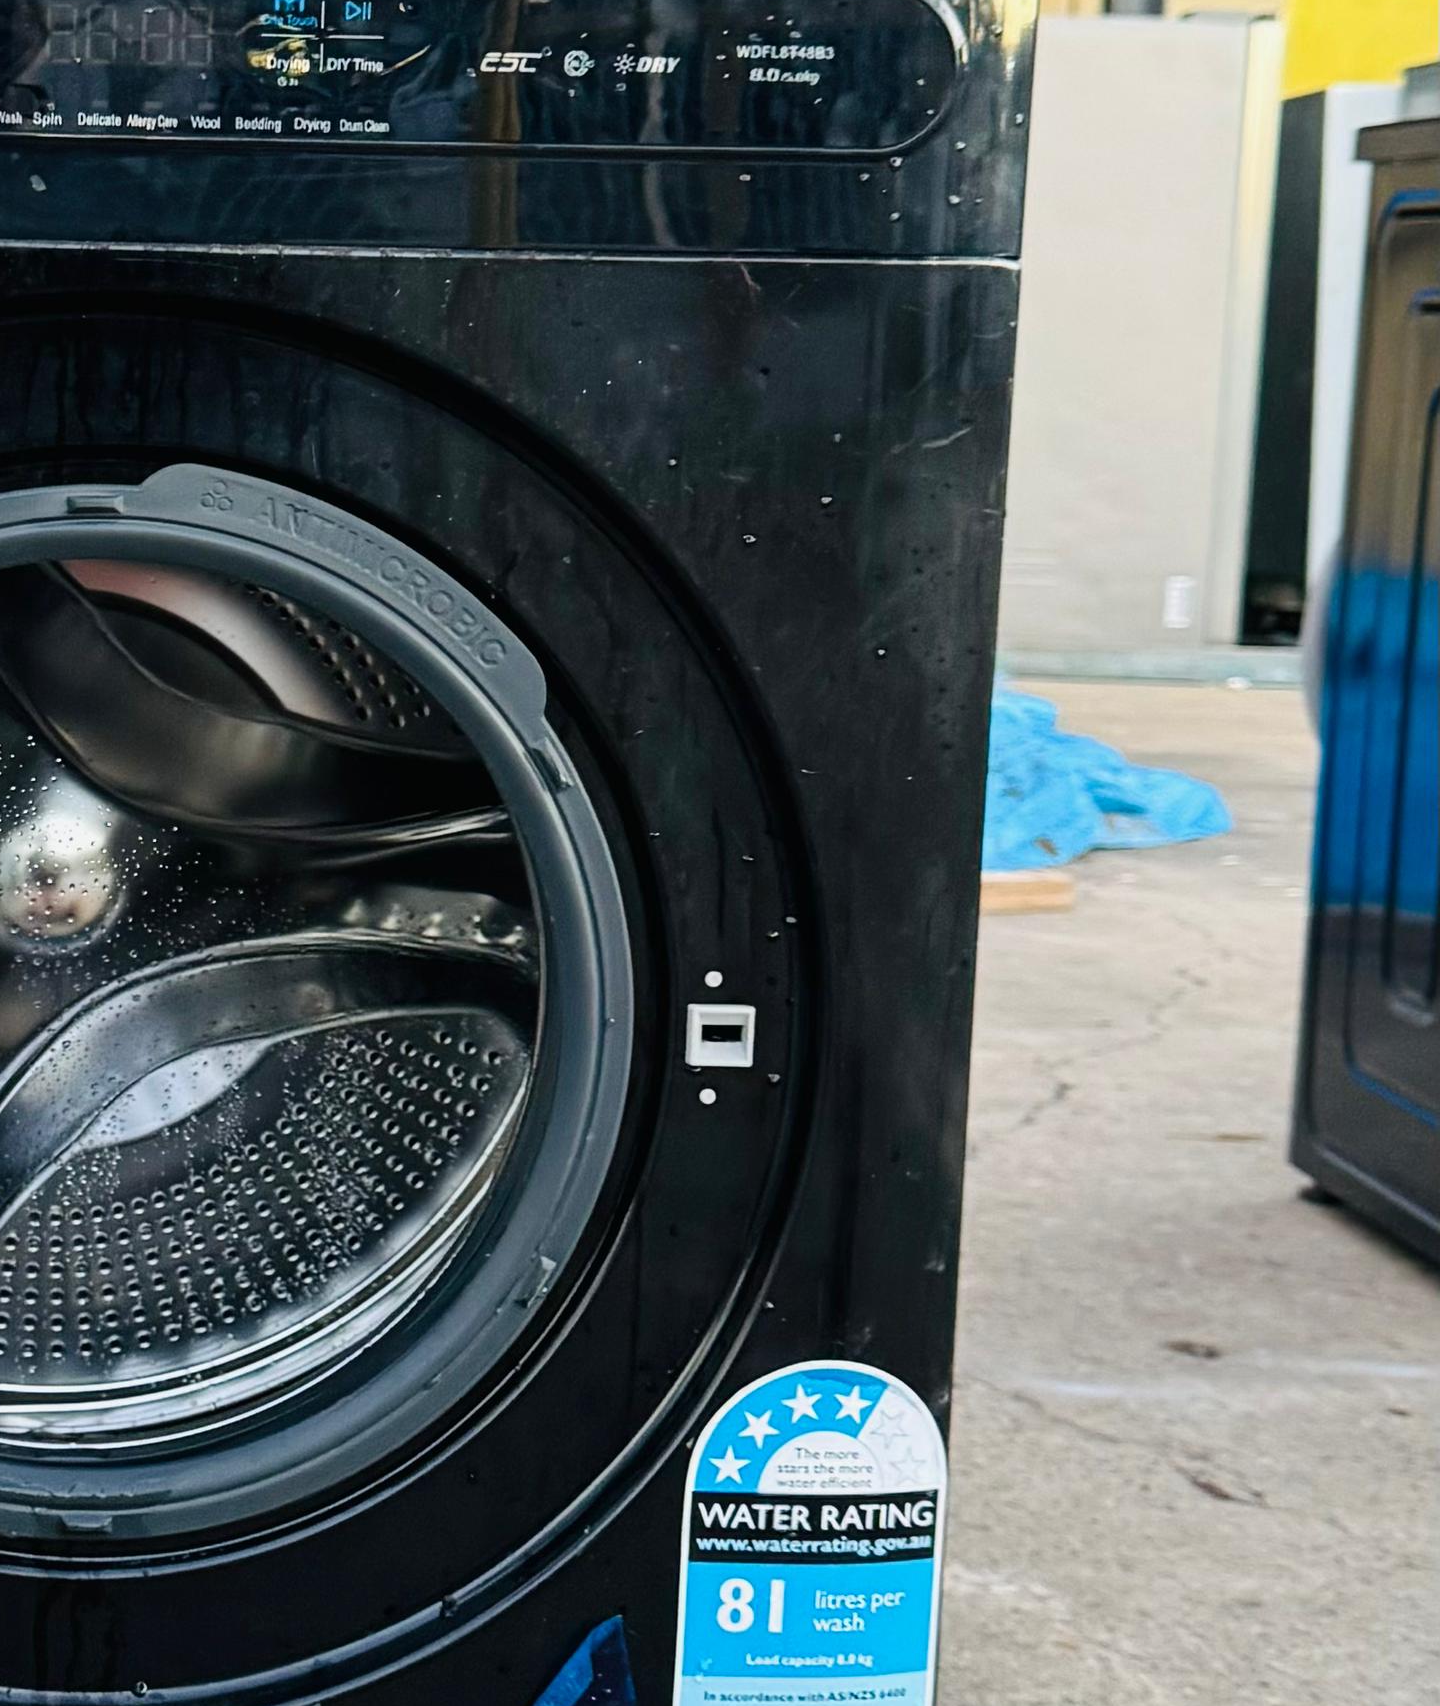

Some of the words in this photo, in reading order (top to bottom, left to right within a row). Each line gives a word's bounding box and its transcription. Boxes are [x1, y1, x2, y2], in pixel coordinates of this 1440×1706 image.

[267, 56, 310, 73] Drying
[327, 57, 350, 71] DIY
[351, 57, 384, 73] Time
[636, 56, 681, 73] DRY
[32, 111, 63, 128] Spin
[77, 112, 122, 127] Delicate
[126, 113, 157, 131] Allergy
[157, 114, 179, 129] Care
[190, 114, 221, 130] Wool
[235, 116, 282, 134] Bedding
[294, 116, 331, 134] Drying
[339, 118, 364, 133] Drum
[364, 119, 390, 133] Clean
[795, 1447, 820, 1460] The
[824, 1449, 859, 1460] more
[777, 1464, 809, 1475] stars
[814, 1462, 835, 1474] the
[839, 1463, 874, 1475] more
[777, 1477, 814, 1489] water
[820, 1477, 872, 1489] efficient
[698, 1502, 811, 1531] WATER
[820, 1500, 935, 1531] RATING
[696, 1535, 932, 1557] www.waterrating.gov.au
[716, 1578, 785, 1633] 81
[815, 1589, 867, 1609] litres
[870, 1591, 905, 1613] per
[813, 1612, 865, 1632] wash
